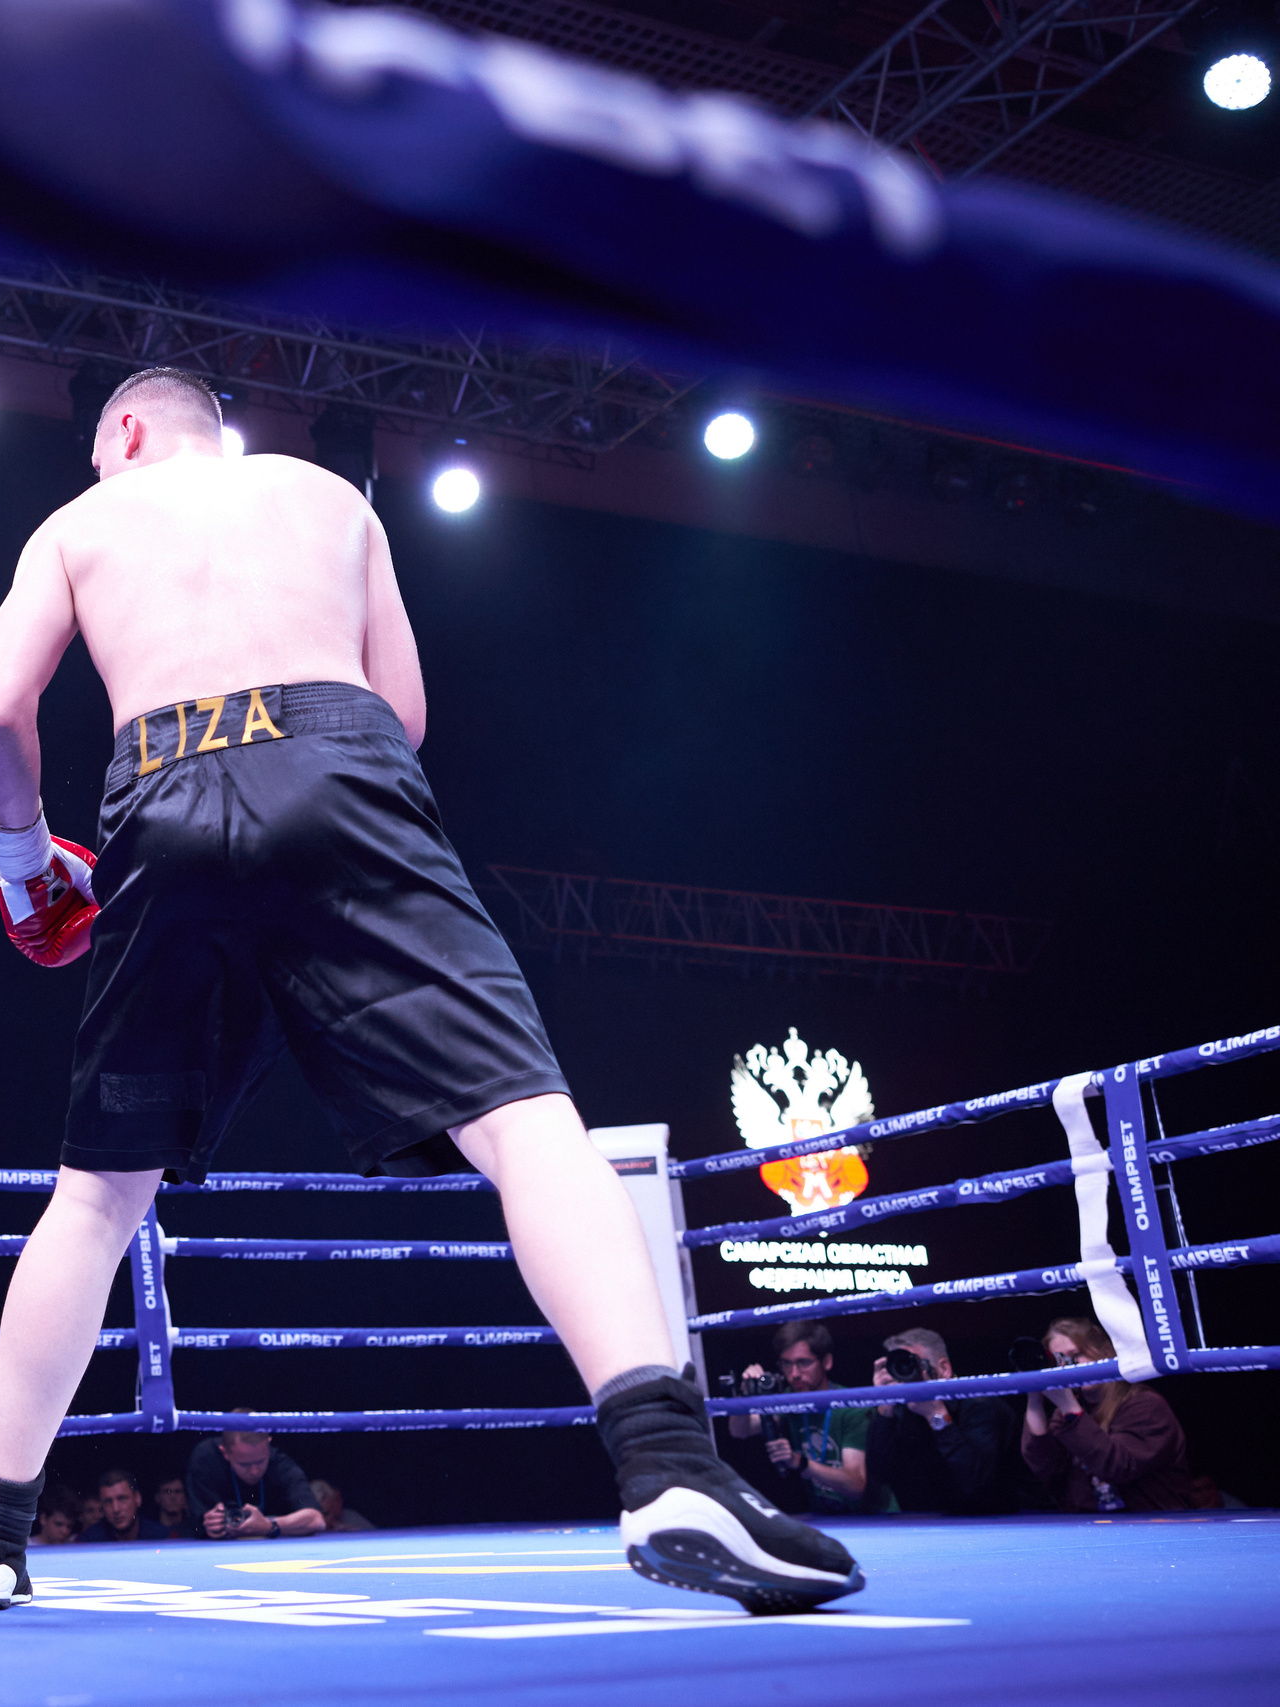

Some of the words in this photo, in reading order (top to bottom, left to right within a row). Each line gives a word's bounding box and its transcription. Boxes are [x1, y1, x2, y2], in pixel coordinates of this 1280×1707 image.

[138, 689, 284, 776] LIZA
[965, 1082, 1050, 1111] OLIMPBET
[870, 1106, 946, 1138] OLIMPBET
[779, 1134, 847, 1159] OLIMPBET
[704, 1152, 767, 1173] OLIMPBET
[959, 1172, 1046, 1195] OLIMPBET
[1120, 1120, 1150, 1230] OLIMPBET
[861, 1191, 939, 1218] OLIMPBET
[780, 1211, 846, 1238] OLIMPBET
[330, 1247, 413, 1260] OLIMPBET
[429, 1245, 507, 1259] OLIMPBET
[933, 1274, 1017, 1295] OLIMPBET
[1144, 1255, 1179, 1370] OLIMPBET
[259, 1333, 343, 1346] OLIMPBET
[366, 1334, 448, 1347] OLIMPBET
[464, 1332, 543, 1346] OLIMPBET
